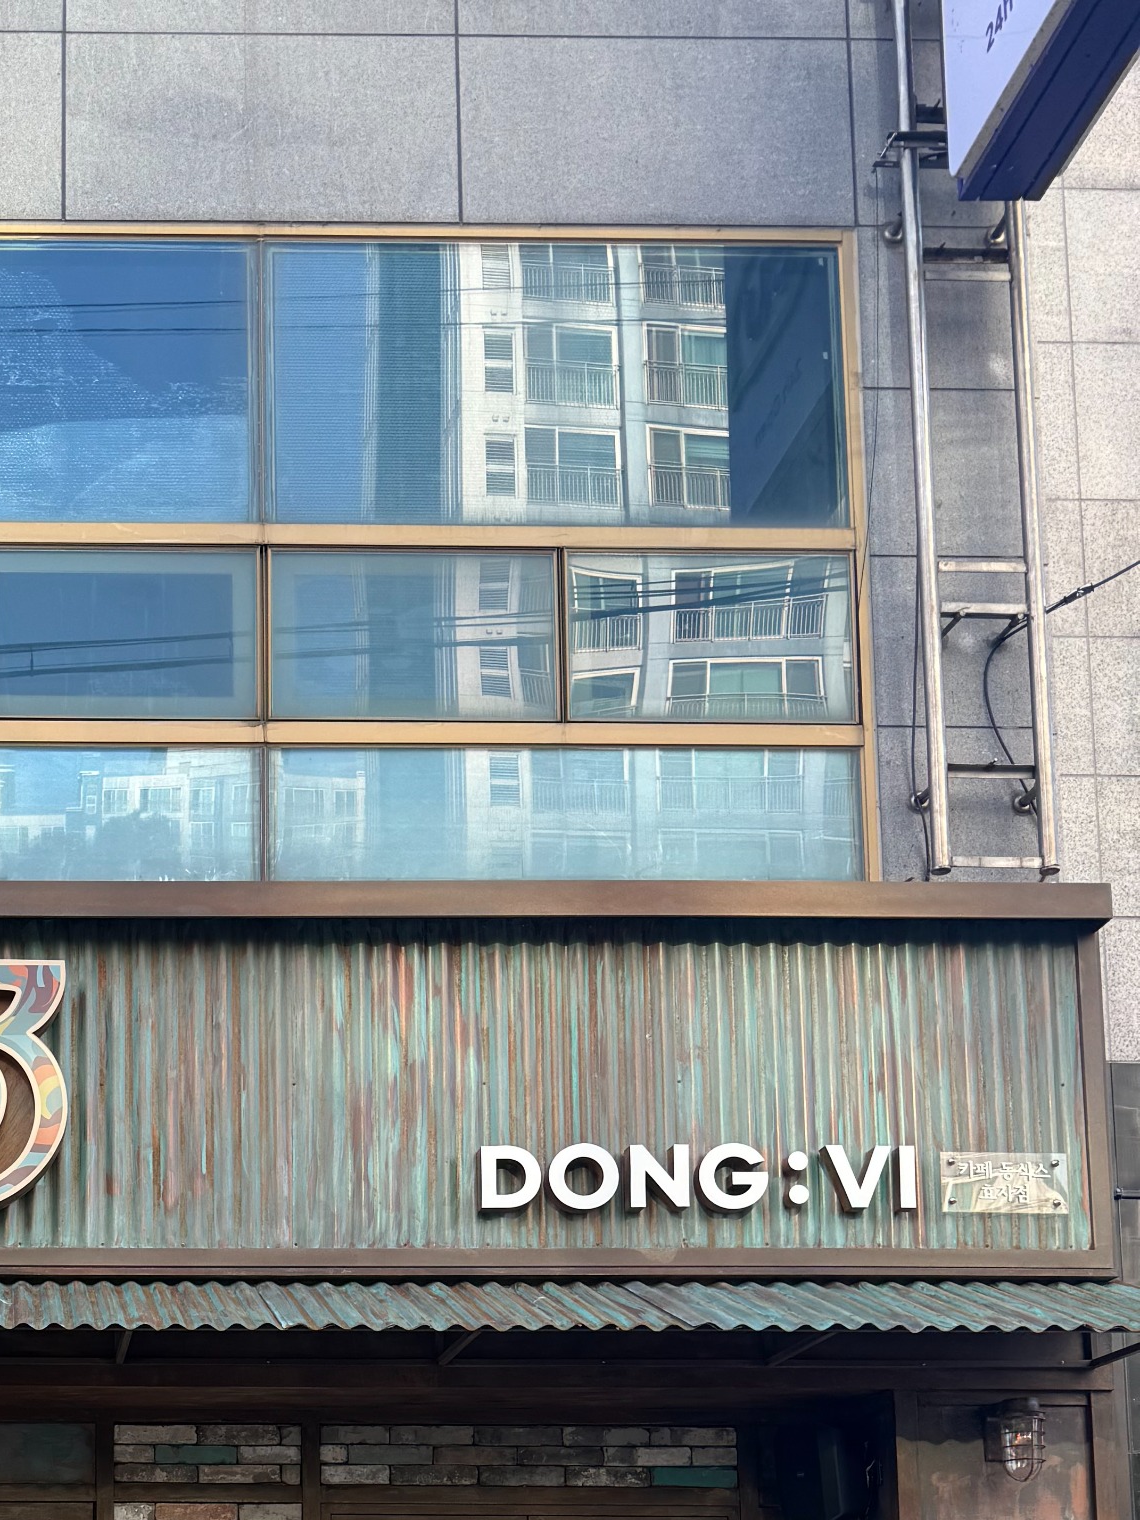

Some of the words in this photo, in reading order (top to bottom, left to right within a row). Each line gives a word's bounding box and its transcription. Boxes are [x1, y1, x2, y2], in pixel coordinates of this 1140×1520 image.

[478, 1142, 917, 1212] DONG:VI
[957, 1160, 992, 1179] 카페
[979, 1184, 1030, 1203] 효자점
